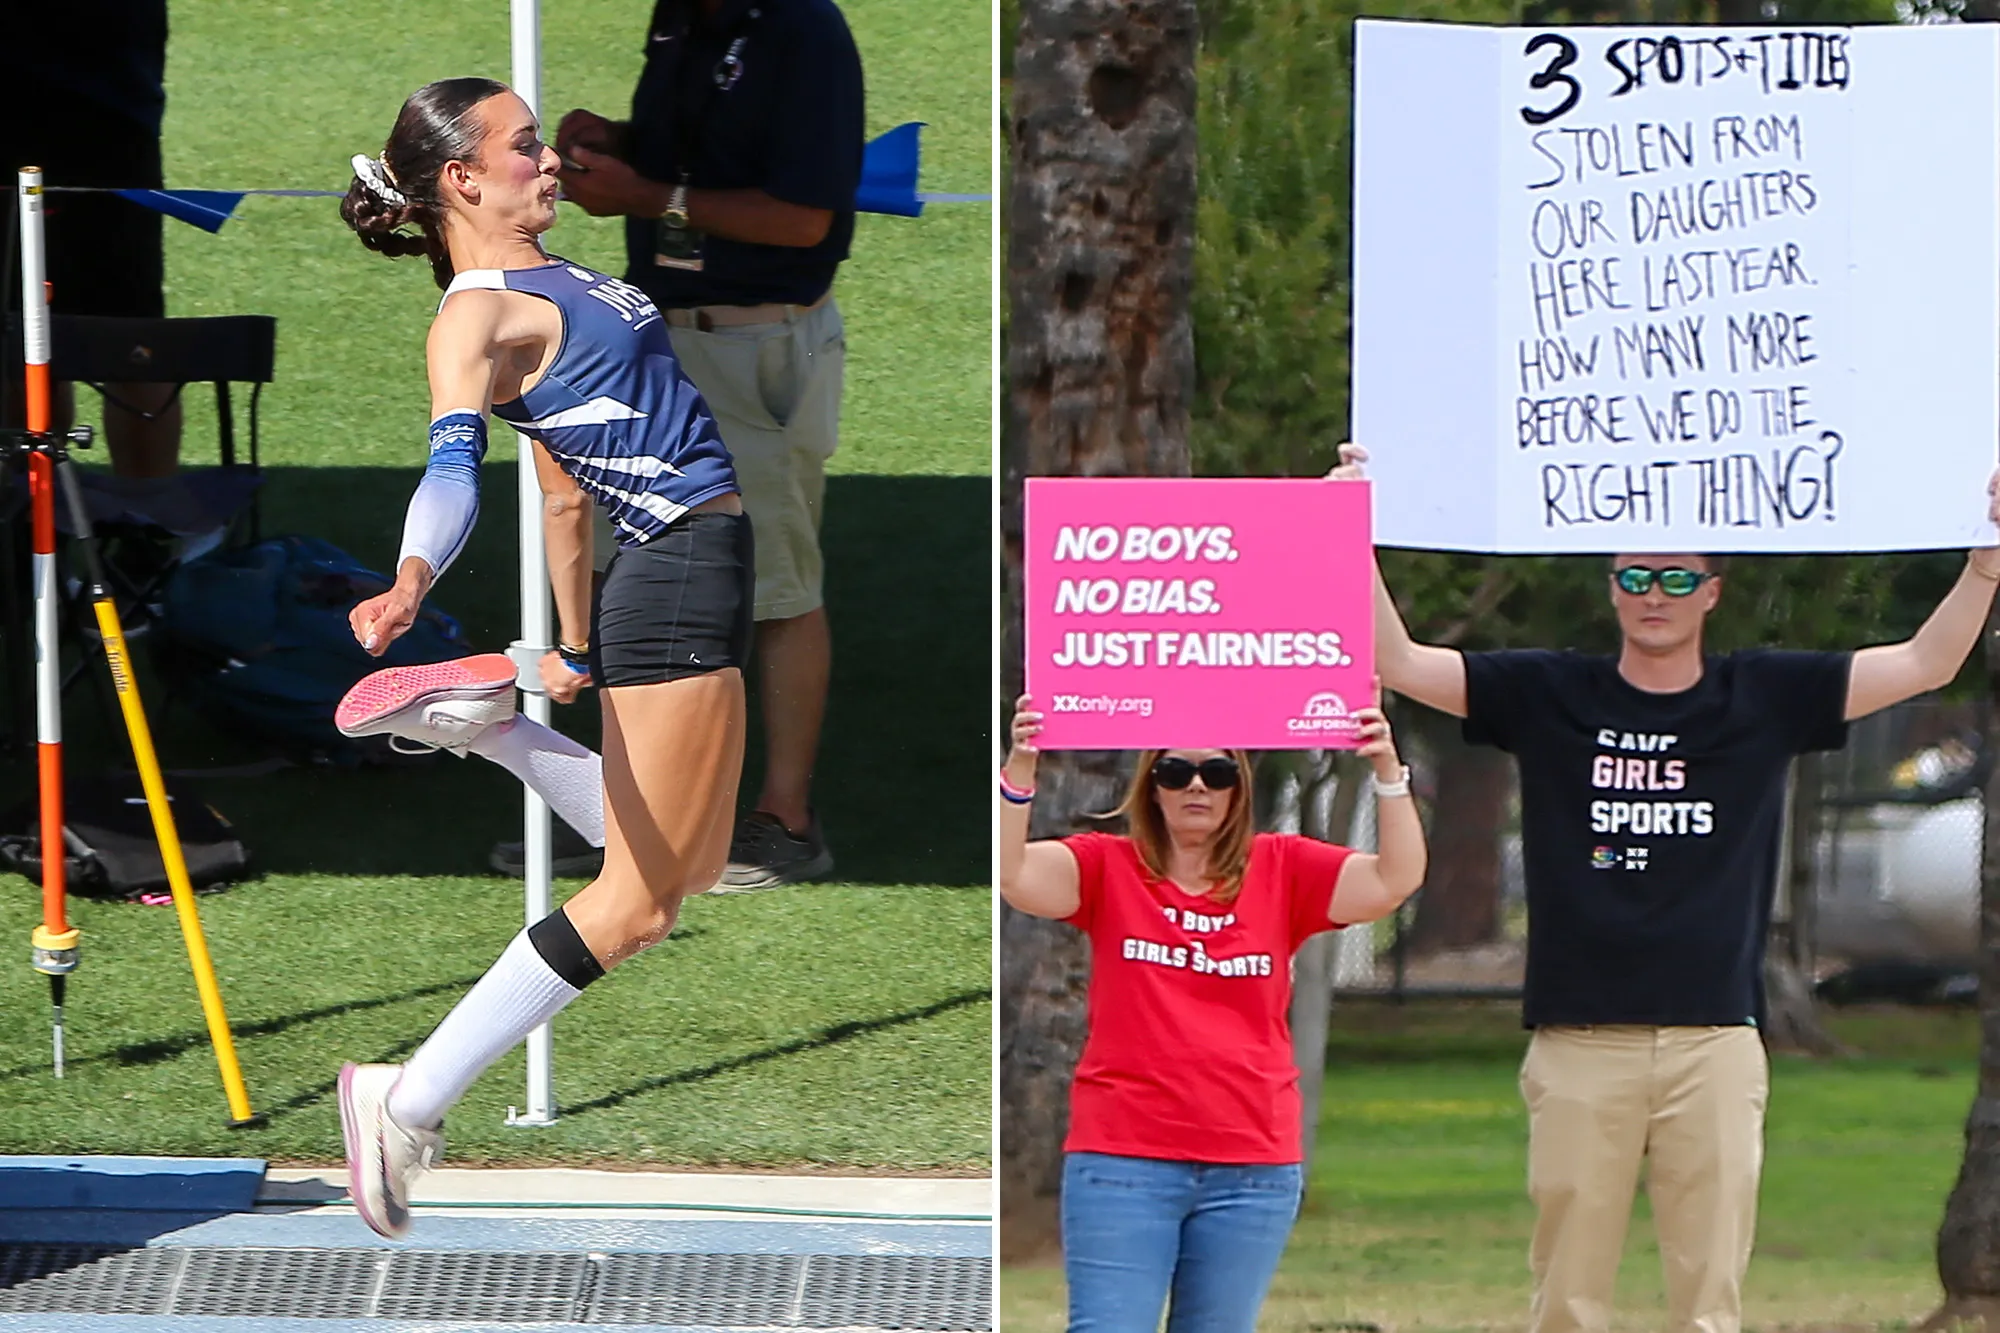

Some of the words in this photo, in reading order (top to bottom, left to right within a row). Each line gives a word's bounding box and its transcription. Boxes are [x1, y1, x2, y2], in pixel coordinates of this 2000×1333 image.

[1520, 33, 1582, 125] 3
[1526, 121, 1693, 189] STOLEN
[1713, 114, 1802, 160] FROM
[1531, 198, 1617, 259] OUR
[1631, 171, 1817, 246] DAUGHTERS
[1530, 255, 1630, 336] HERE
[1643, 251, 1722, 312] LAST
[1725, 243, 1819, 294] YEAR.
[1519, 335, 1600, 393] HOW
[1613, 315, 1706, 380] MANY
[1728, 315, 1819, 373] MORE
[1517, 394, 1634, 449] BEFORE
[1640, 391, 1696, 443] WE
[1706, 389, 1743, 441] DO
[1752, 385, 1816, 436] THE
[1541, 459, 1678, 528] RIGHT
[1683, 431, 1844, 528] THING?
[1054, 526, 1119, 561] NO
[1122, 526, 1239, 562] BOYS.
[1054, 579, 1119, 613] NO
[1121, 579, 1221, 614] BIAS.
[1052, 632, 1152, 666] JUST
[1156, 632, 1352, 667] FAIRNESS.
[1053, 695, 1153, 717] XXonly.org
[1591, 754, 1687, 791] GIRLS
[1590, 800, 1715, 835] SPORTS
[1123, 938, 1189, 968] GIRLS
